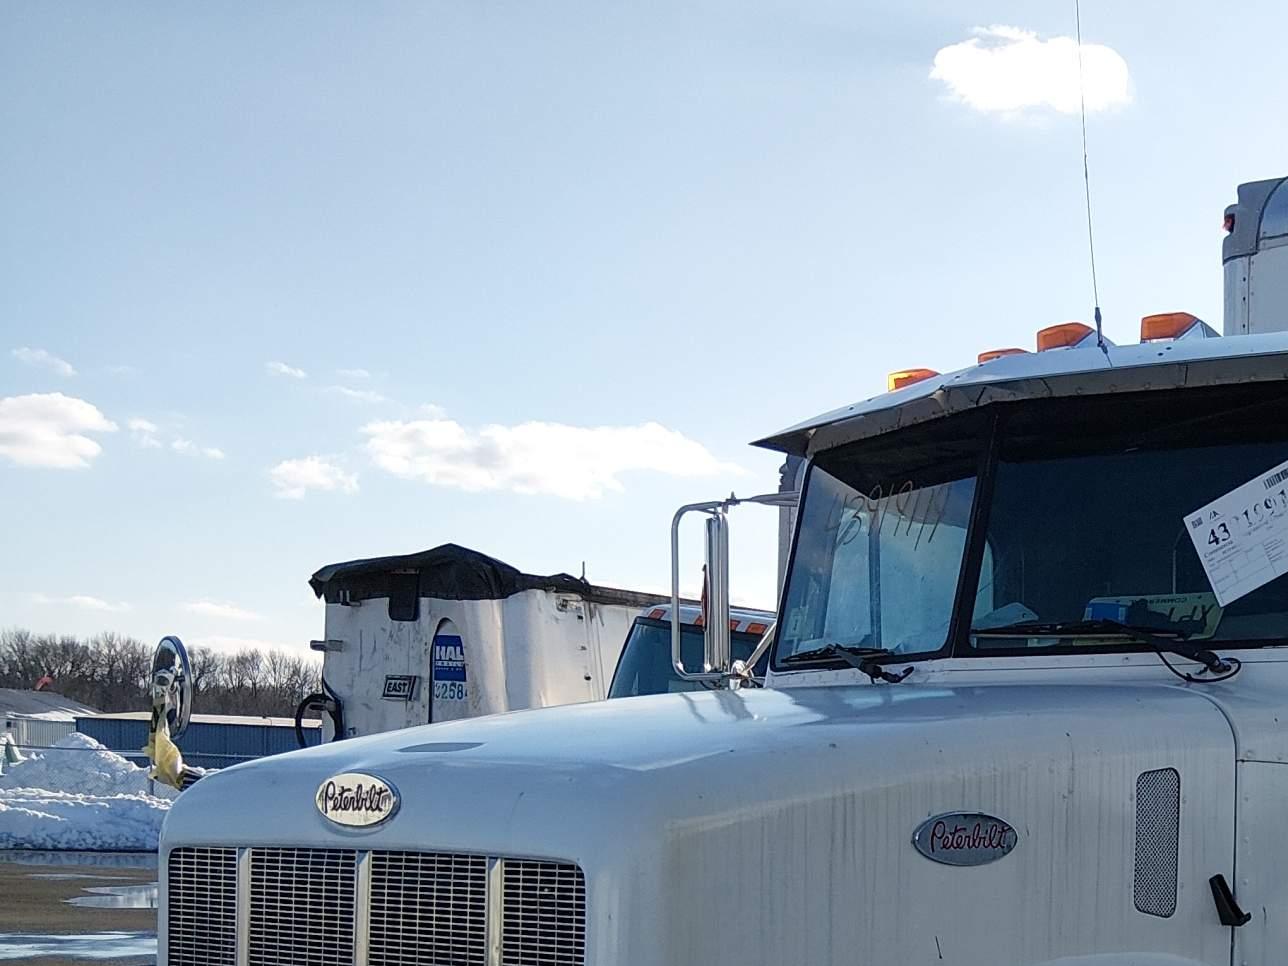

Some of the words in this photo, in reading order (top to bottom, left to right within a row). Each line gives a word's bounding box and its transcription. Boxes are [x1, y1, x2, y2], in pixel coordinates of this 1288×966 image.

[386, 682, 408, 693] EAST
[324, 780, 390, 815] Peterbilt
[930, 820, 1013, 853] Peterbilt
